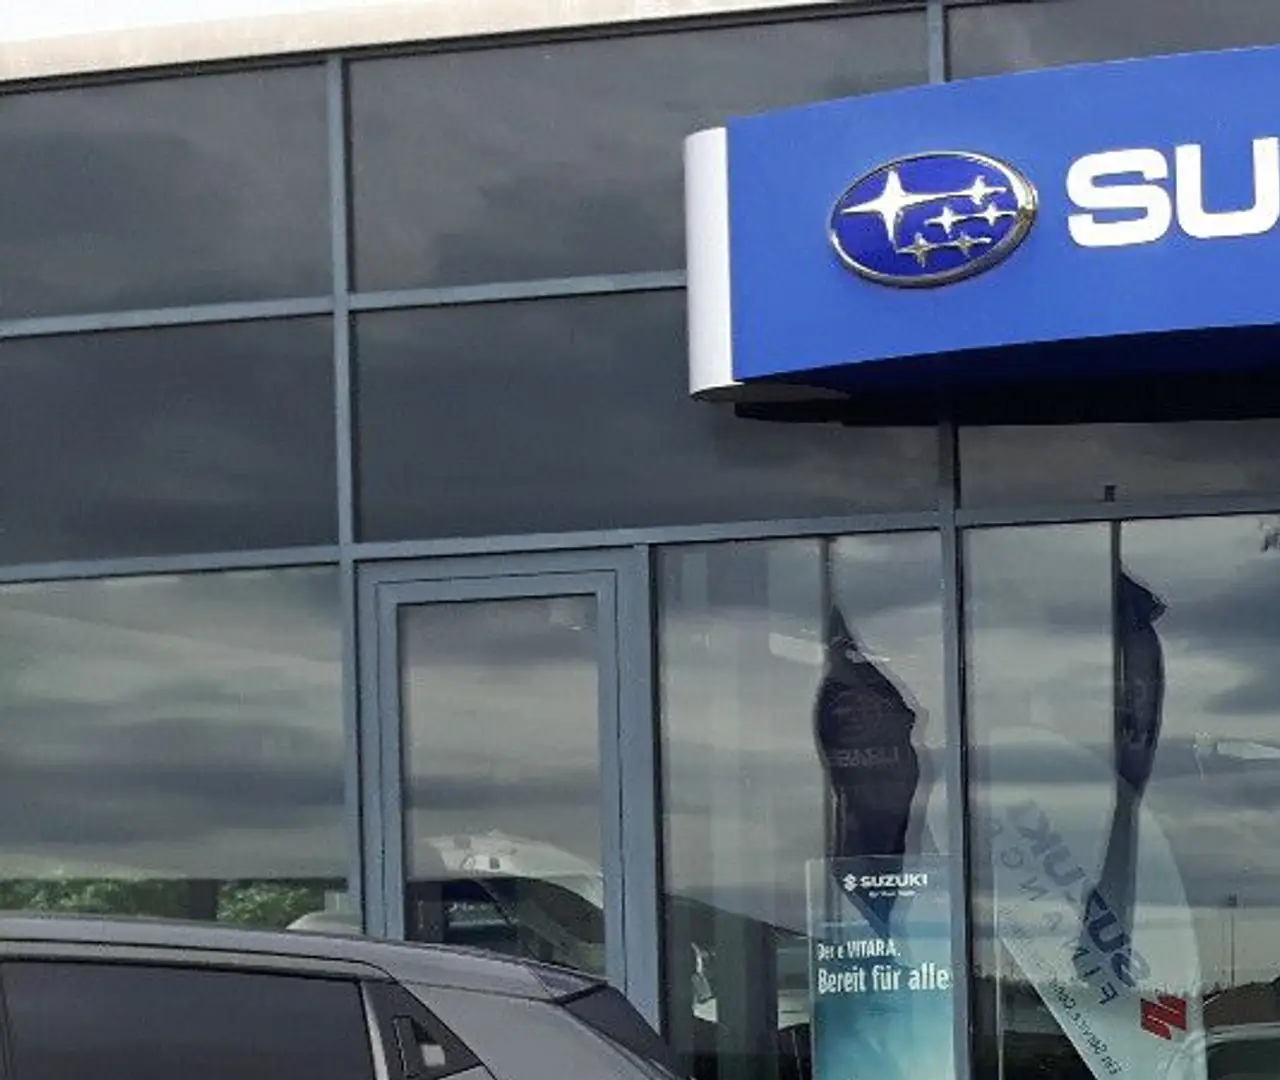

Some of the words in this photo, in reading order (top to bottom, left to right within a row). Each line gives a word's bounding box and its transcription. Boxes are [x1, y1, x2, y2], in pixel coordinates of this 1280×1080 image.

[859, 872, 929, 888] SUZUKI
[817, 964, 867, 994] Bereit
[871, 963, 901, 991] für
[907, 962, 953, 991] alle
